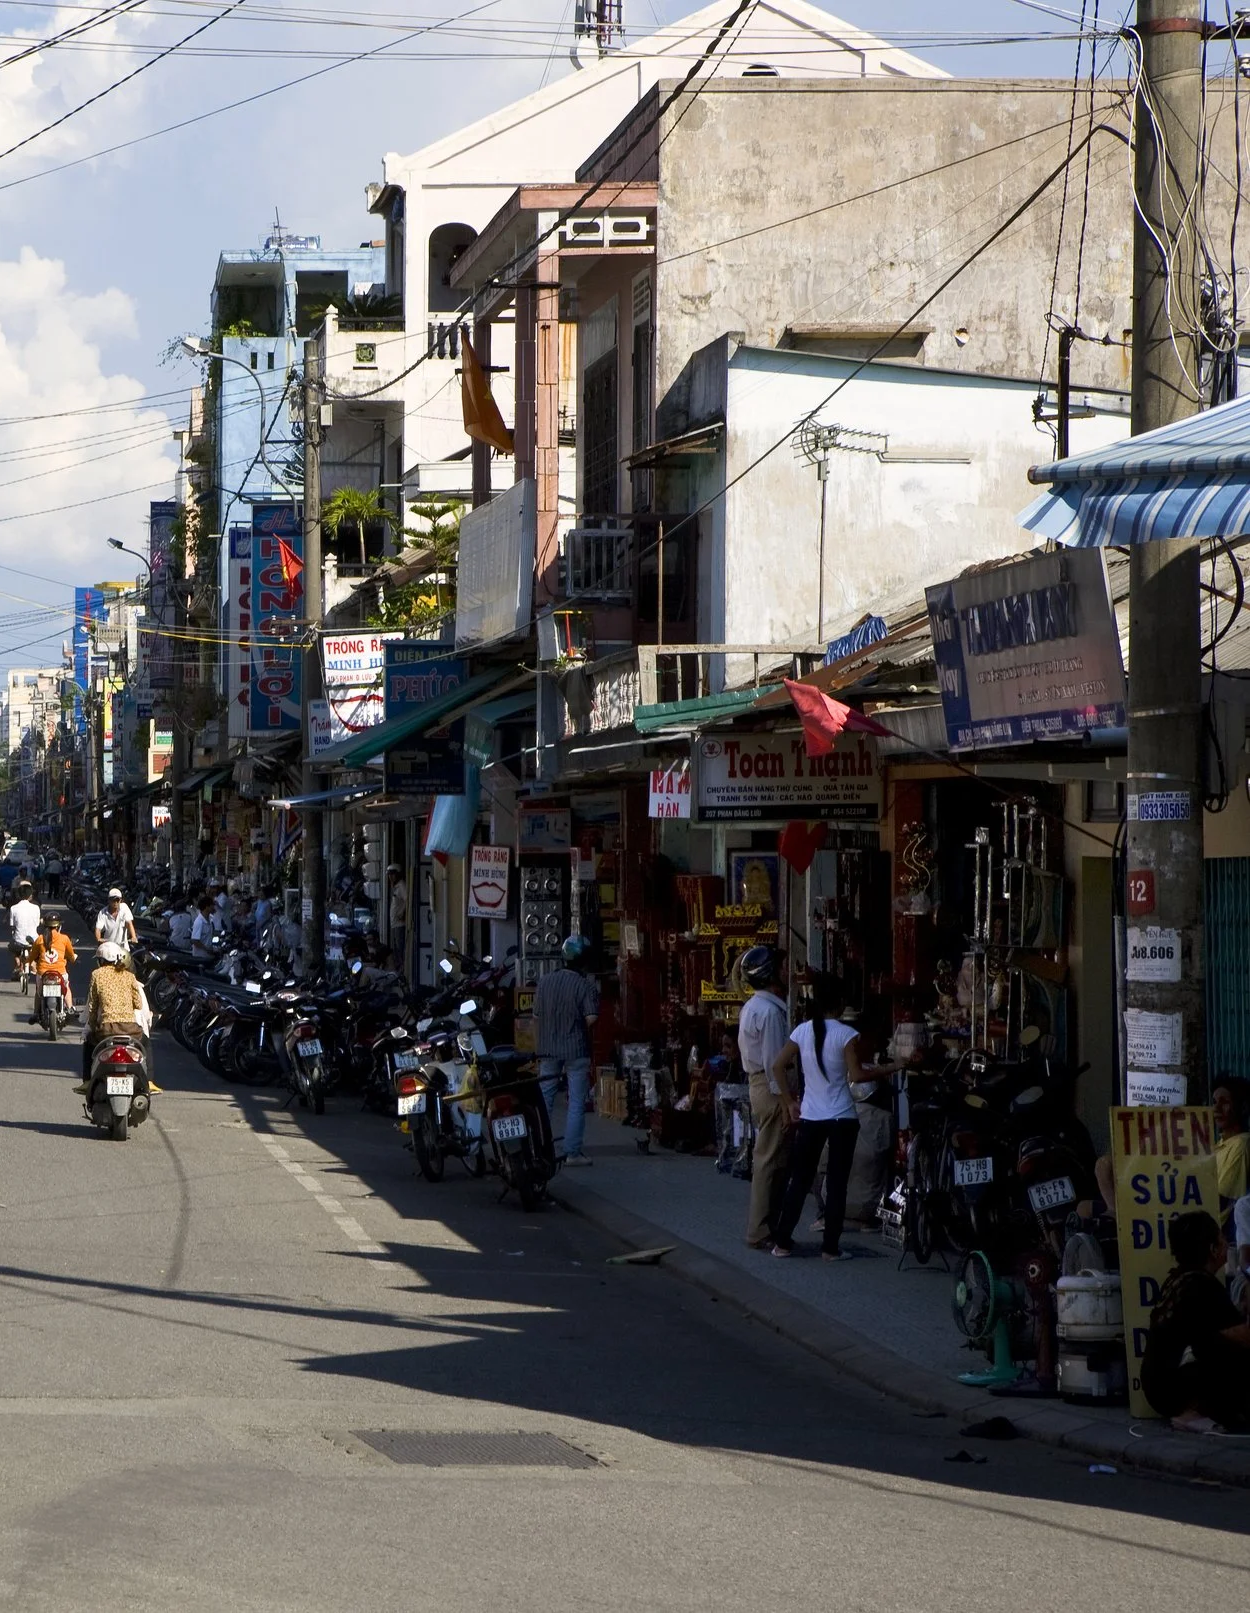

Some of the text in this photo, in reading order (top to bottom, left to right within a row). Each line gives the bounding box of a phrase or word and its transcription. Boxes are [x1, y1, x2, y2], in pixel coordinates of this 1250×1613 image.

[328, 659, 362, 671] MINH
[724, 740, 786, 779] Toàn
[706, 785, 736, 794] CHUYÊN
[716, 795, 740, 803] TRANH
[816, 793, 841, 801] QUANG
[657, 797, 680, 817] HÀN
[1130, 880, 1147, 902] 12
[1117, 1107, 1213, 1161] THIỆN
[959, 1160, 988, 1173] 75-H9
[960, 1171, 989, 1183] 1073
[1131, 1162, 1202, 1205] SỬA
